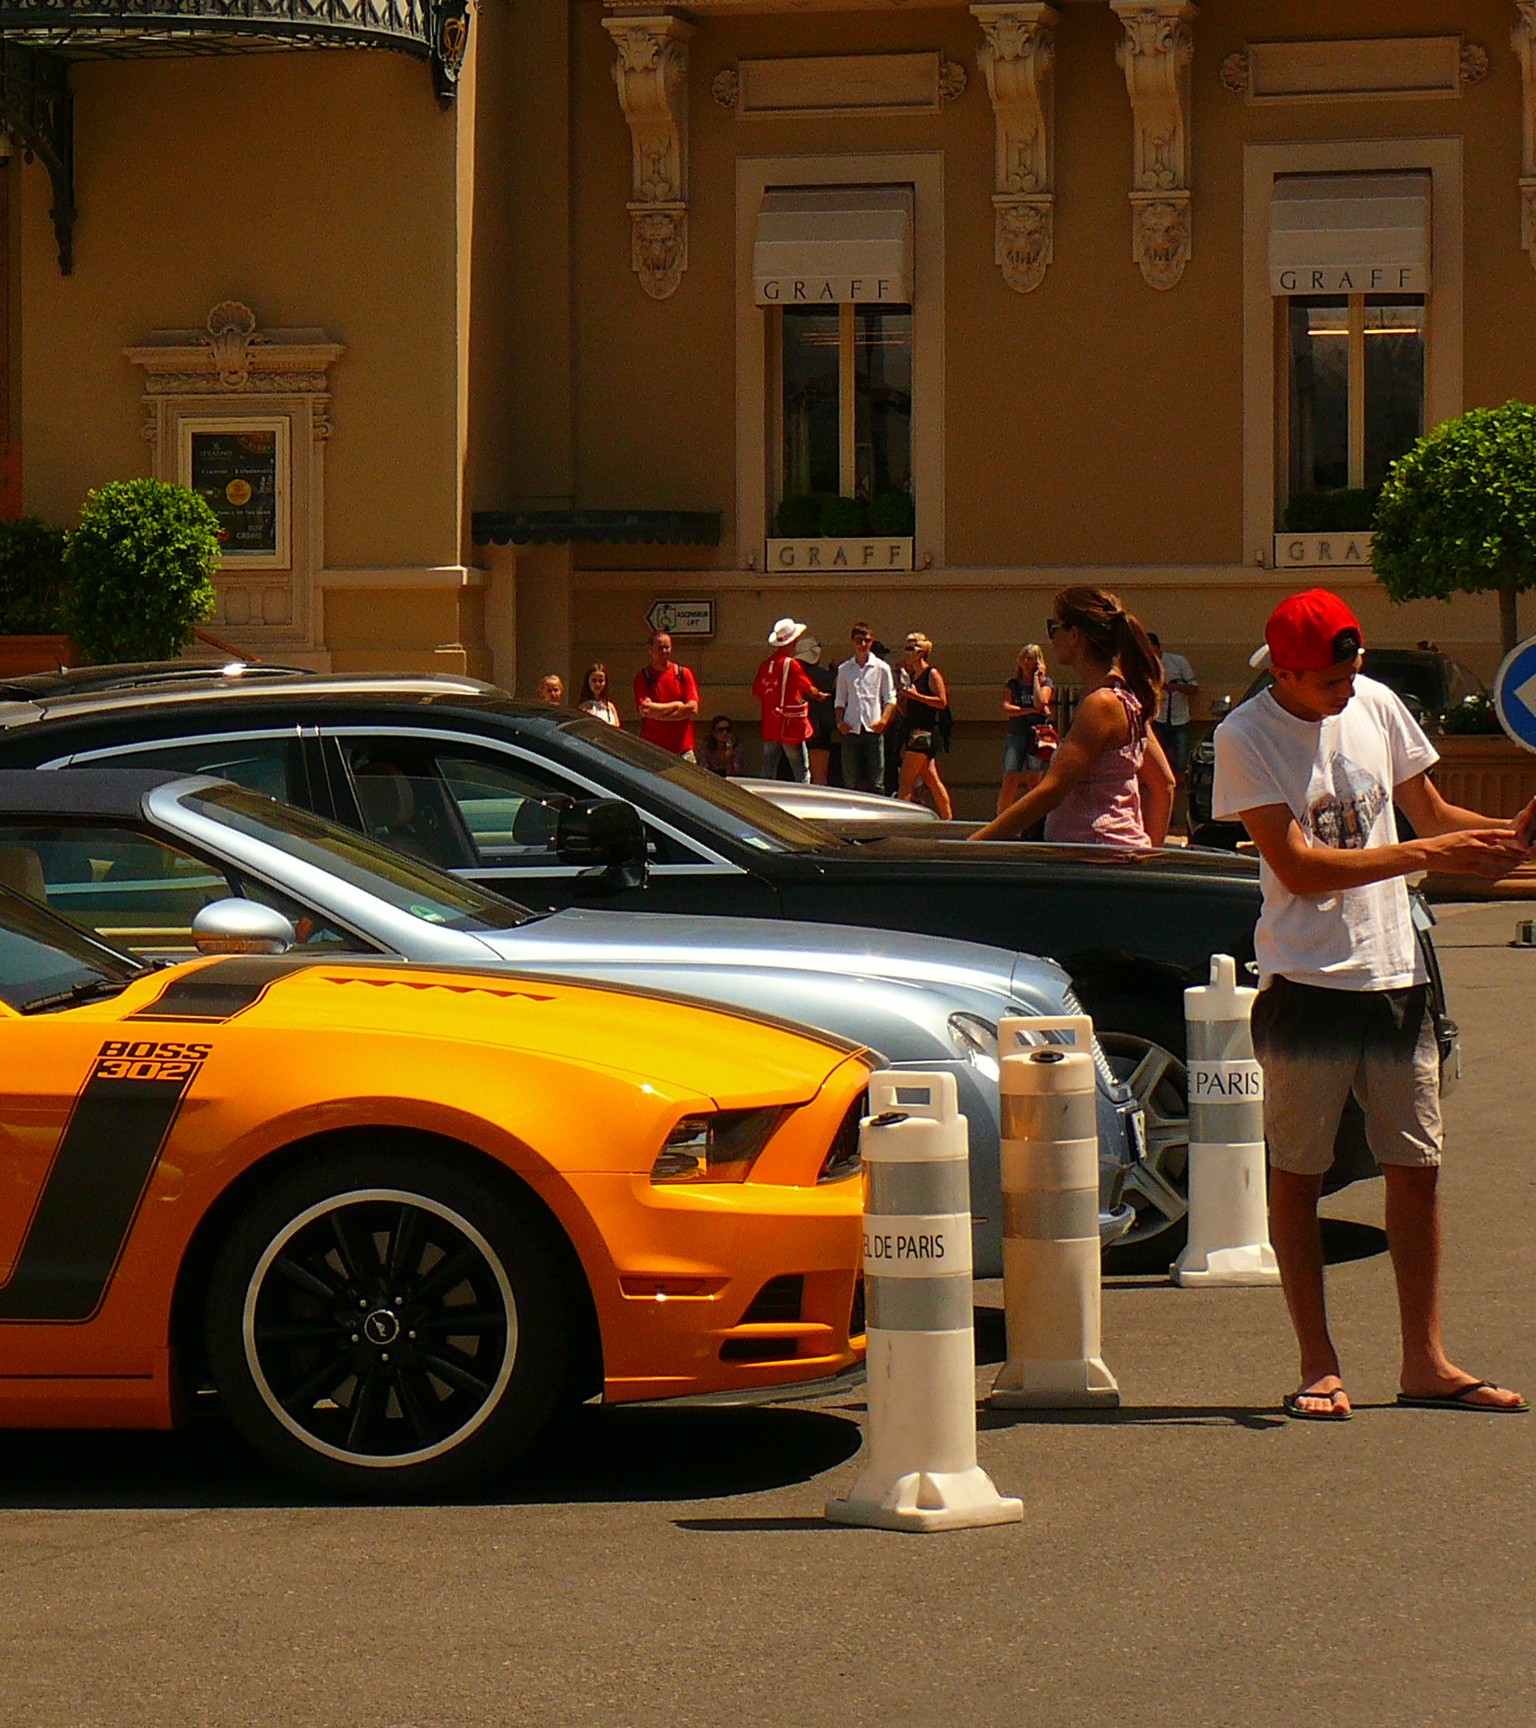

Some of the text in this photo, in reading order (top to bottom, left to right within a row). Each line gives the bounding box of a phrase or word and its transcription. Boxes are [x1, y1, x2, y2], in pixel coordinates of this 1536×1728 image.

[763, 279, 890, 300] GRAFF
[1278, 268, 1412, 291] GRAFF
[779, 545, 901, 566] GRAFF
[1288, 540, 1362, 561] GRA
[97, 1041, 213, 1060] BOSS
[97, 1060, 191, 1080] 302
[1196, 1071, 1259, 1095] PARIS
[874, 1234, 892, 1259] DE
[897, 1234, 944, 1259] PARIS
